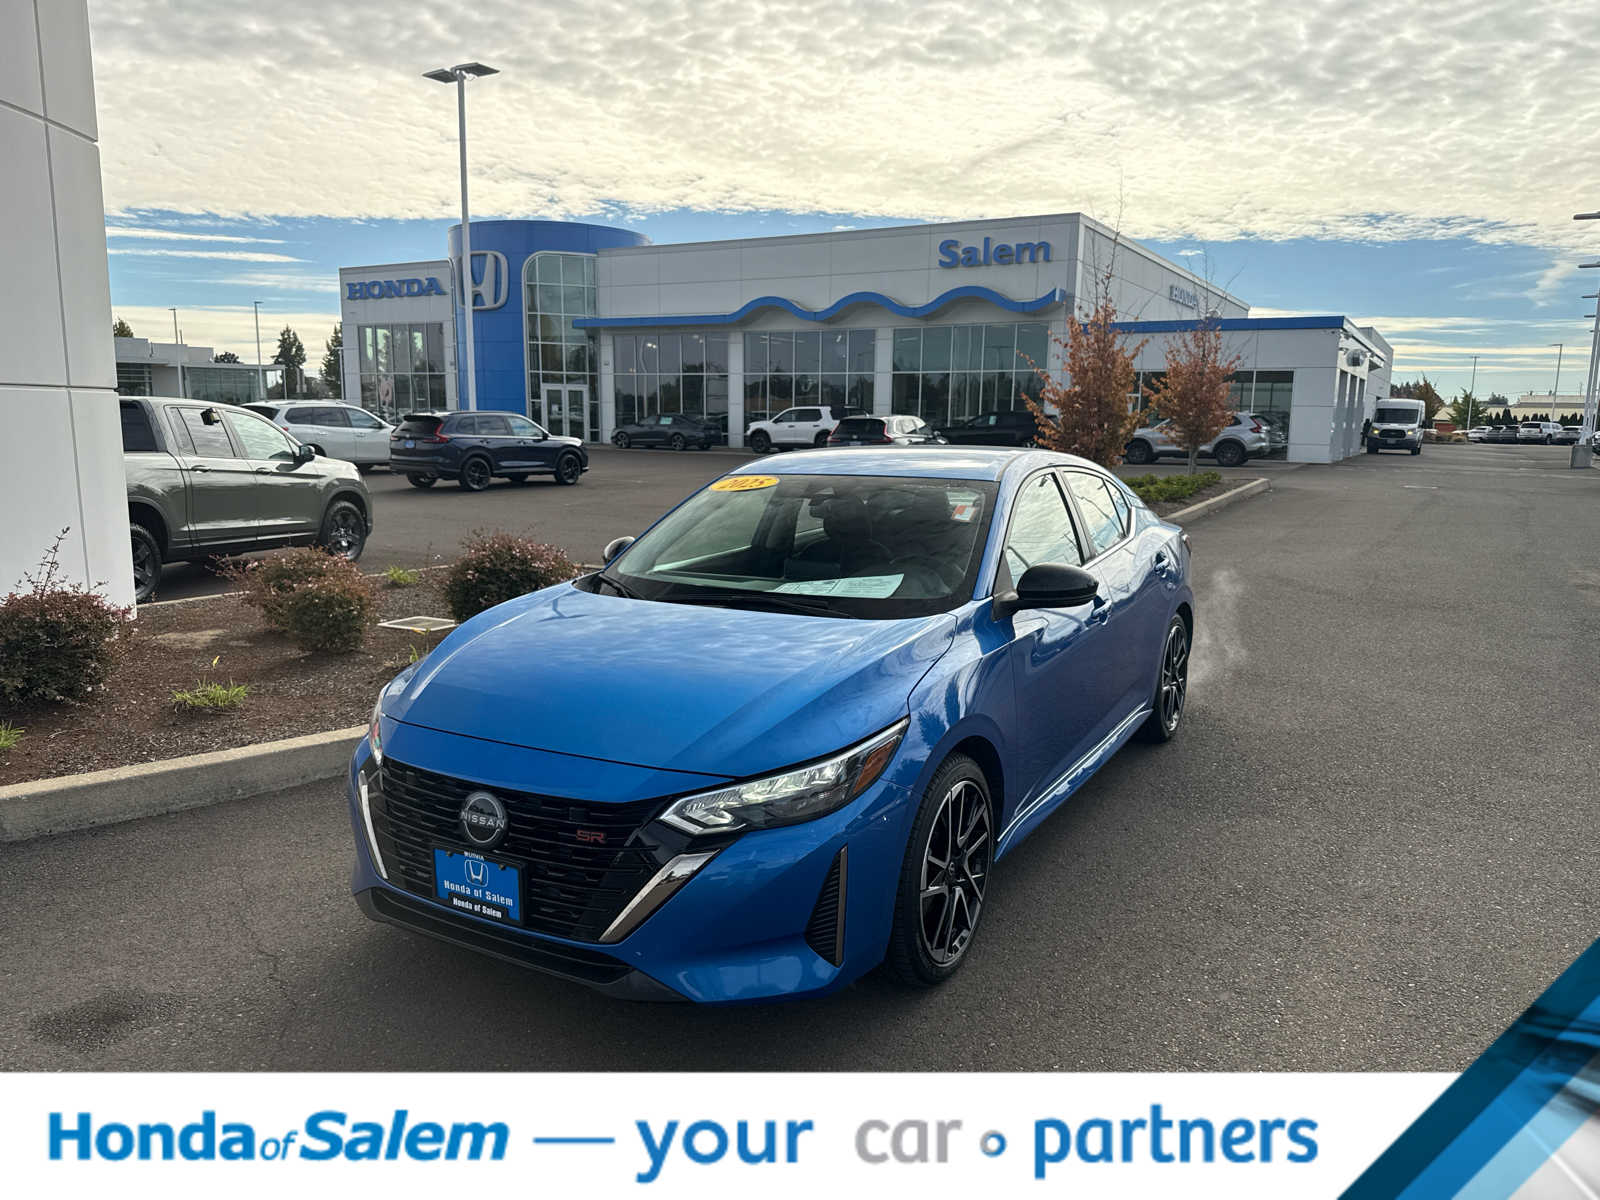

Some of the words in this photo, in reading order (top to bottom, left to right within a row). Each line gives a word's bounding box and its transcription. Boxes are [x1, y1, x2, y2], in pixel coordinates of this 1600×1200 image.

[938, 236, 1051, 269] Salem
[346, 277, 448, 300] HONDA
[719, 478, 772, 490] 2025
[460, 809, 505, 829] NISSAN
[576, 829, 606, 844] SR
[443, 879, 471, 895] Honda
[473, 888, 482, 898] of
[485, 890, 513, 907] Salem
[452, 897, 473, 911] Honda
[474, 903, 481, 912] of
[482, 905, 502, 919] Salem
